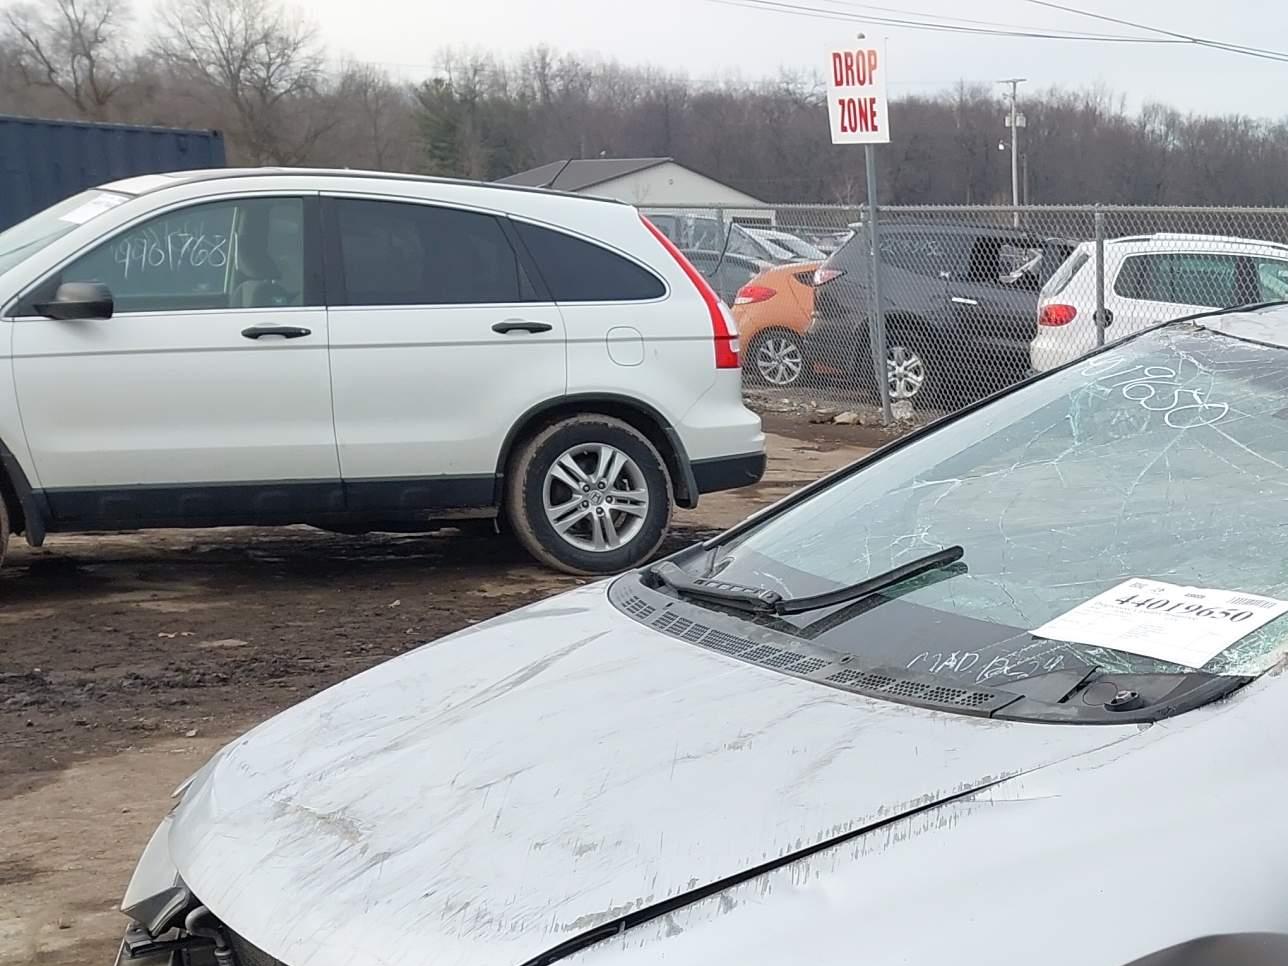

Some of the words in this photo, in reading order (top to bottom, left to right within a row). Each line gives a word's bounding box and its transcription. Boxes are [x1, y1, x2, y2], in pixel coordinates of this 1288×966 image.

[832, 49, 878, 87] DROP
[838, 97, 879, 133] ZONE
[1115, 594, 1254, 623] 44019650
